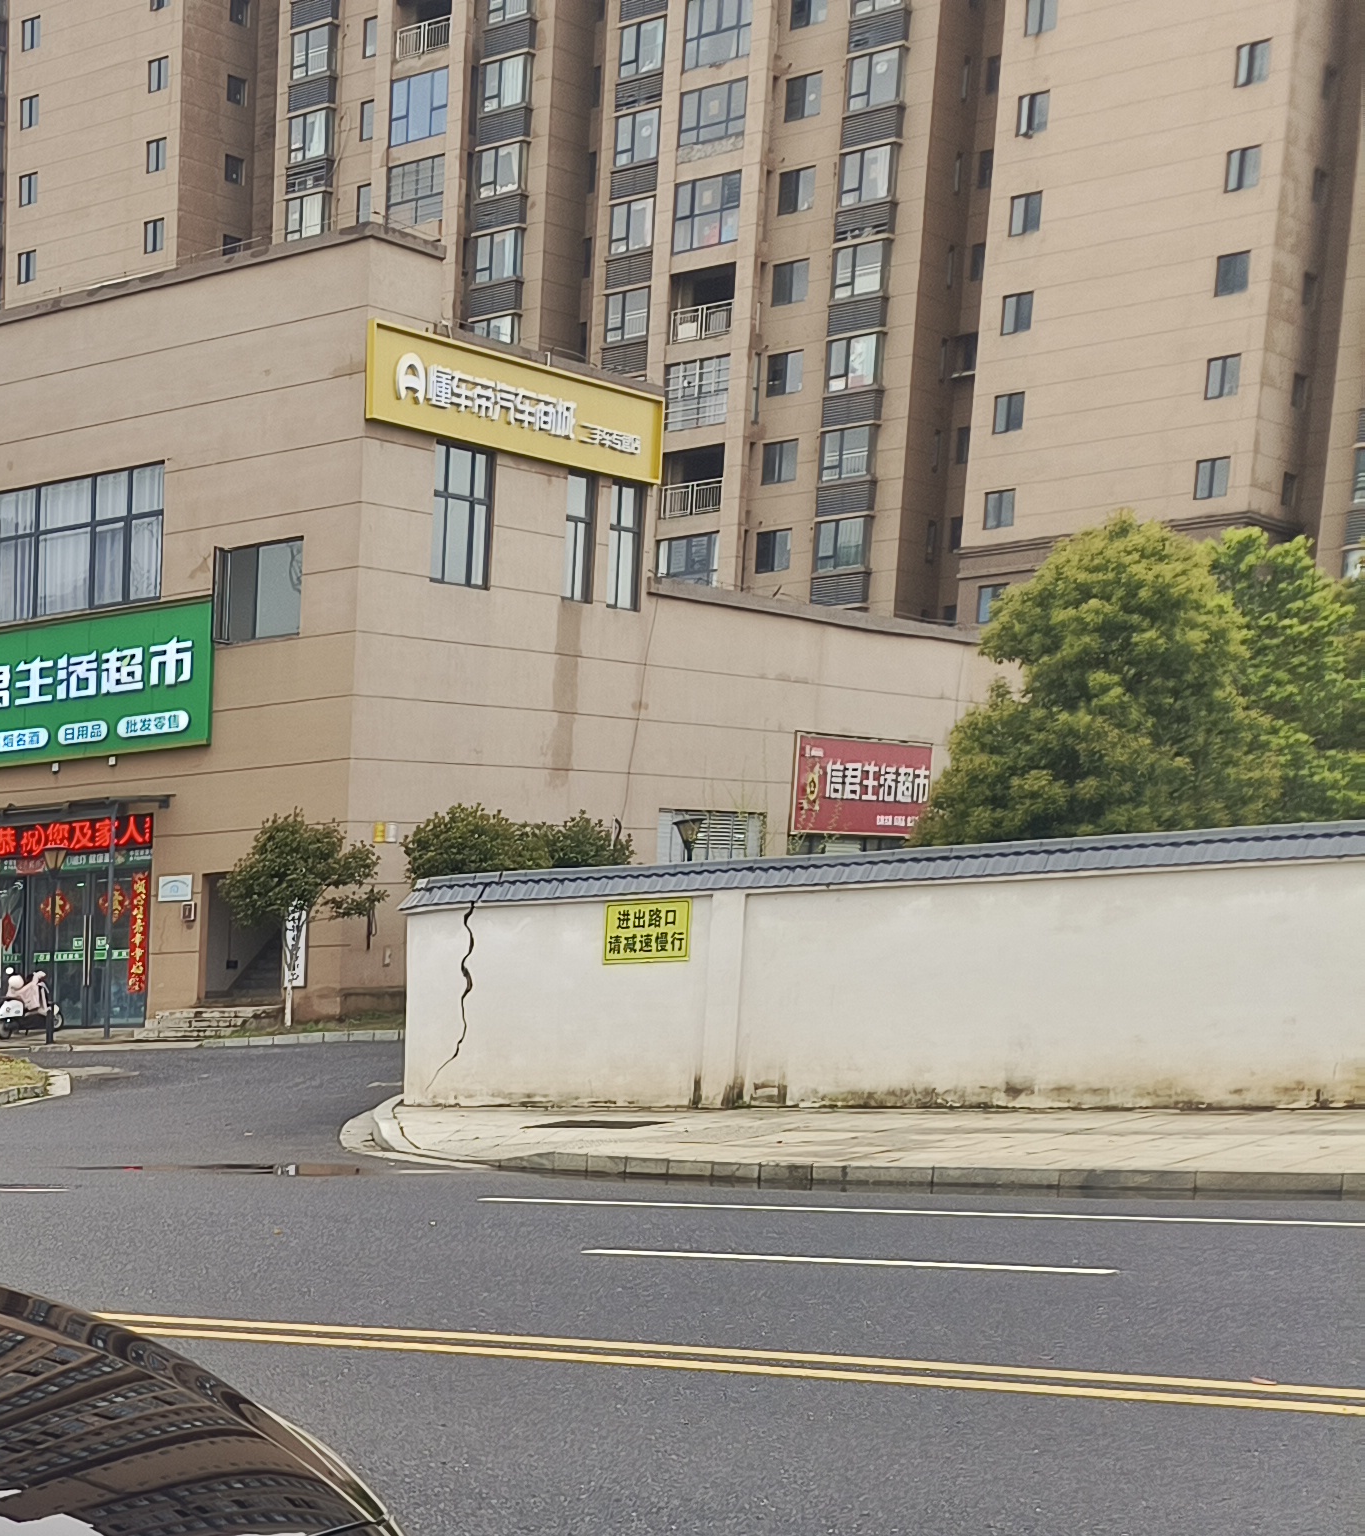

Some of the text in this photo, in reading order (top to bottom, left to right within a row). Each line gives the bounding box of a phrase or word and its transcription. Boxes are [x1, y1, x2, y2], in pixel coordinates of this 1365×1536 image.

[64, 723, 102, 742] 日用品
[125, 714, 180, 735] 批发零售
[825, 758, 930, 804] 信君生活超市
[616, 908, 678, 930] 进出路口
[608, 931, 686, 954] 请减速慢行
